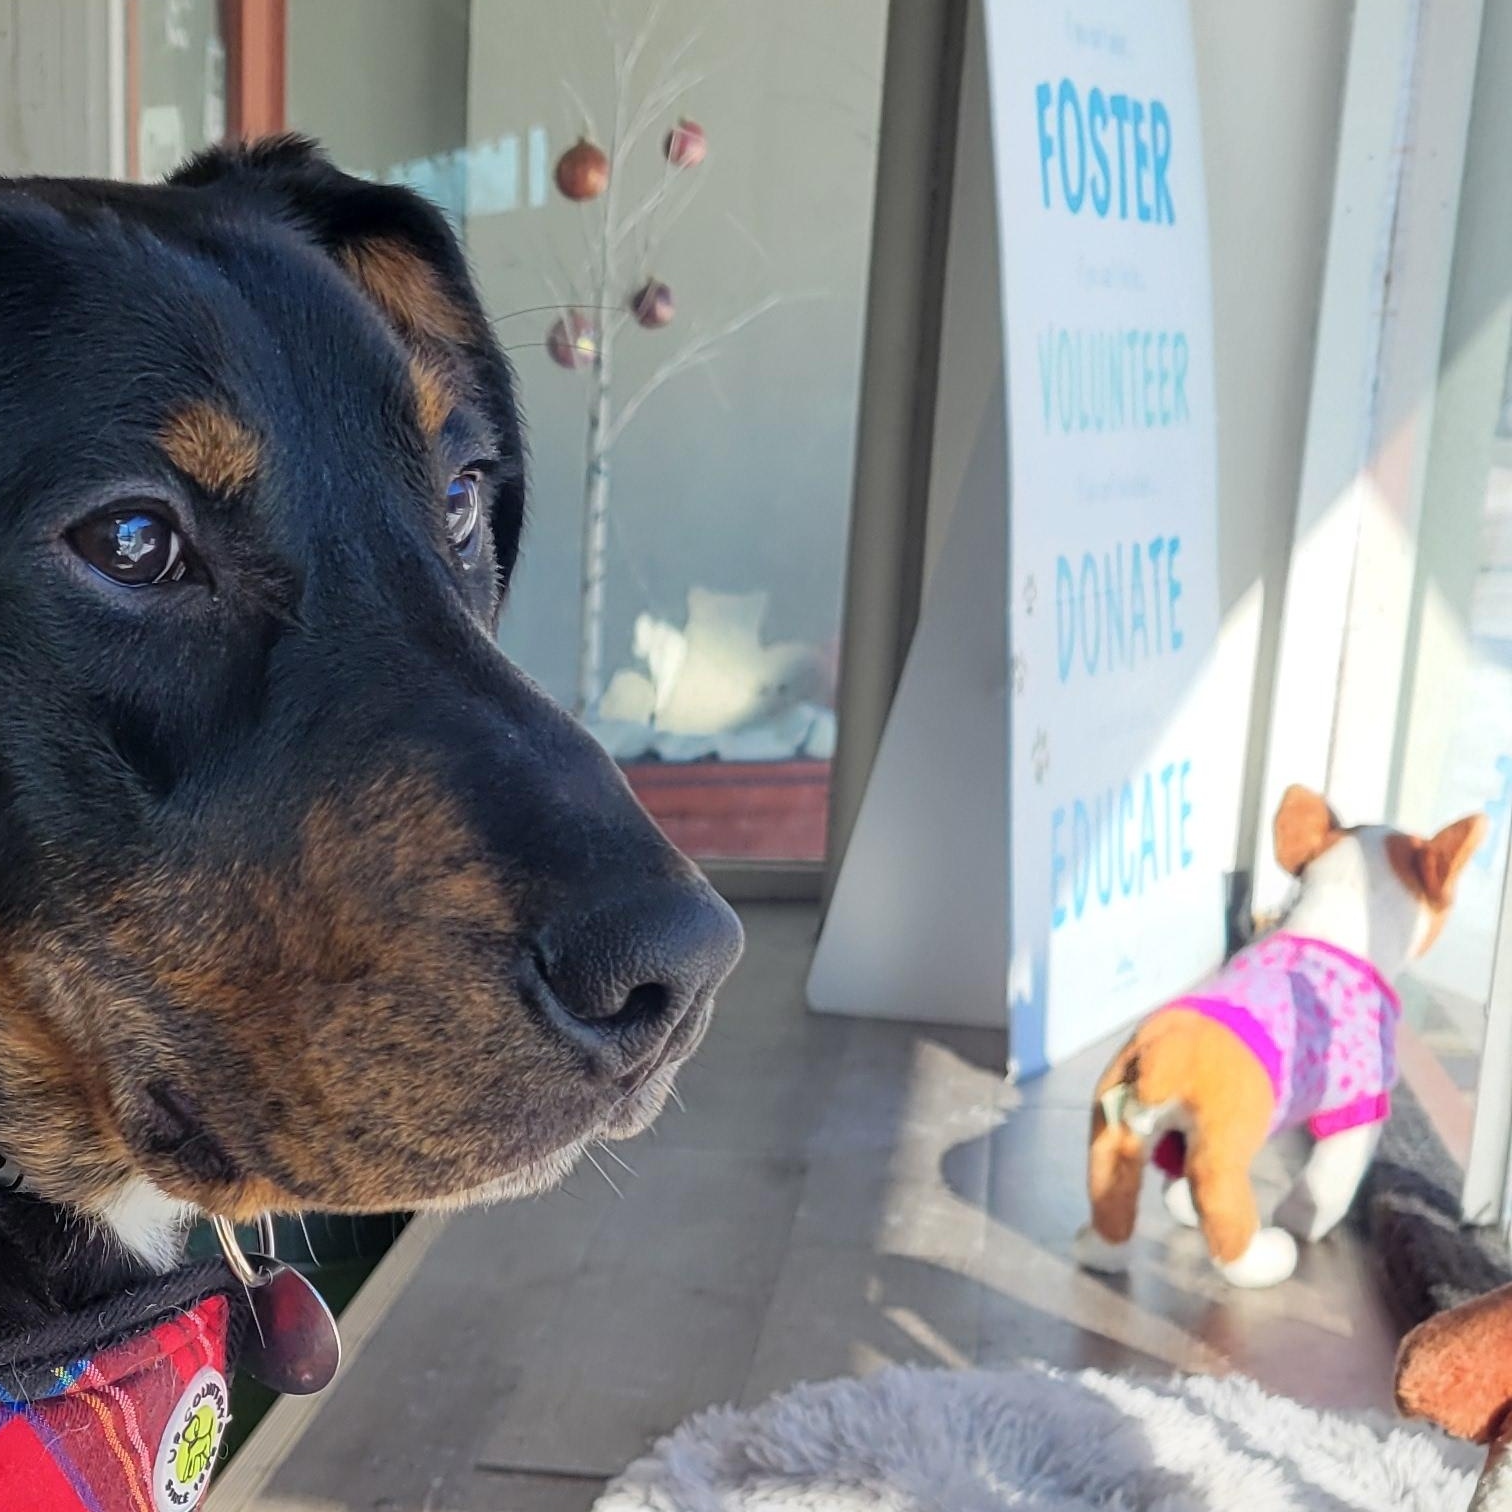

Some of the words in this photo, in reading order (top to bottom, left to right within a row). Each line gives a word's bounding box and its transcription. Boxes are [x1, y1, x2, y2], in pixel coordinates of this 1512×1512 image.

[1036, 77, 1176, 226] FOSTER
[1038, 327, 1190, 434] VOLUNTEER
[1056, 535, 1184, 685] DONATE
[1051, 760, 1193, 931] EDUCATE
[185, 1383, 225, 1422] COUNTRY
